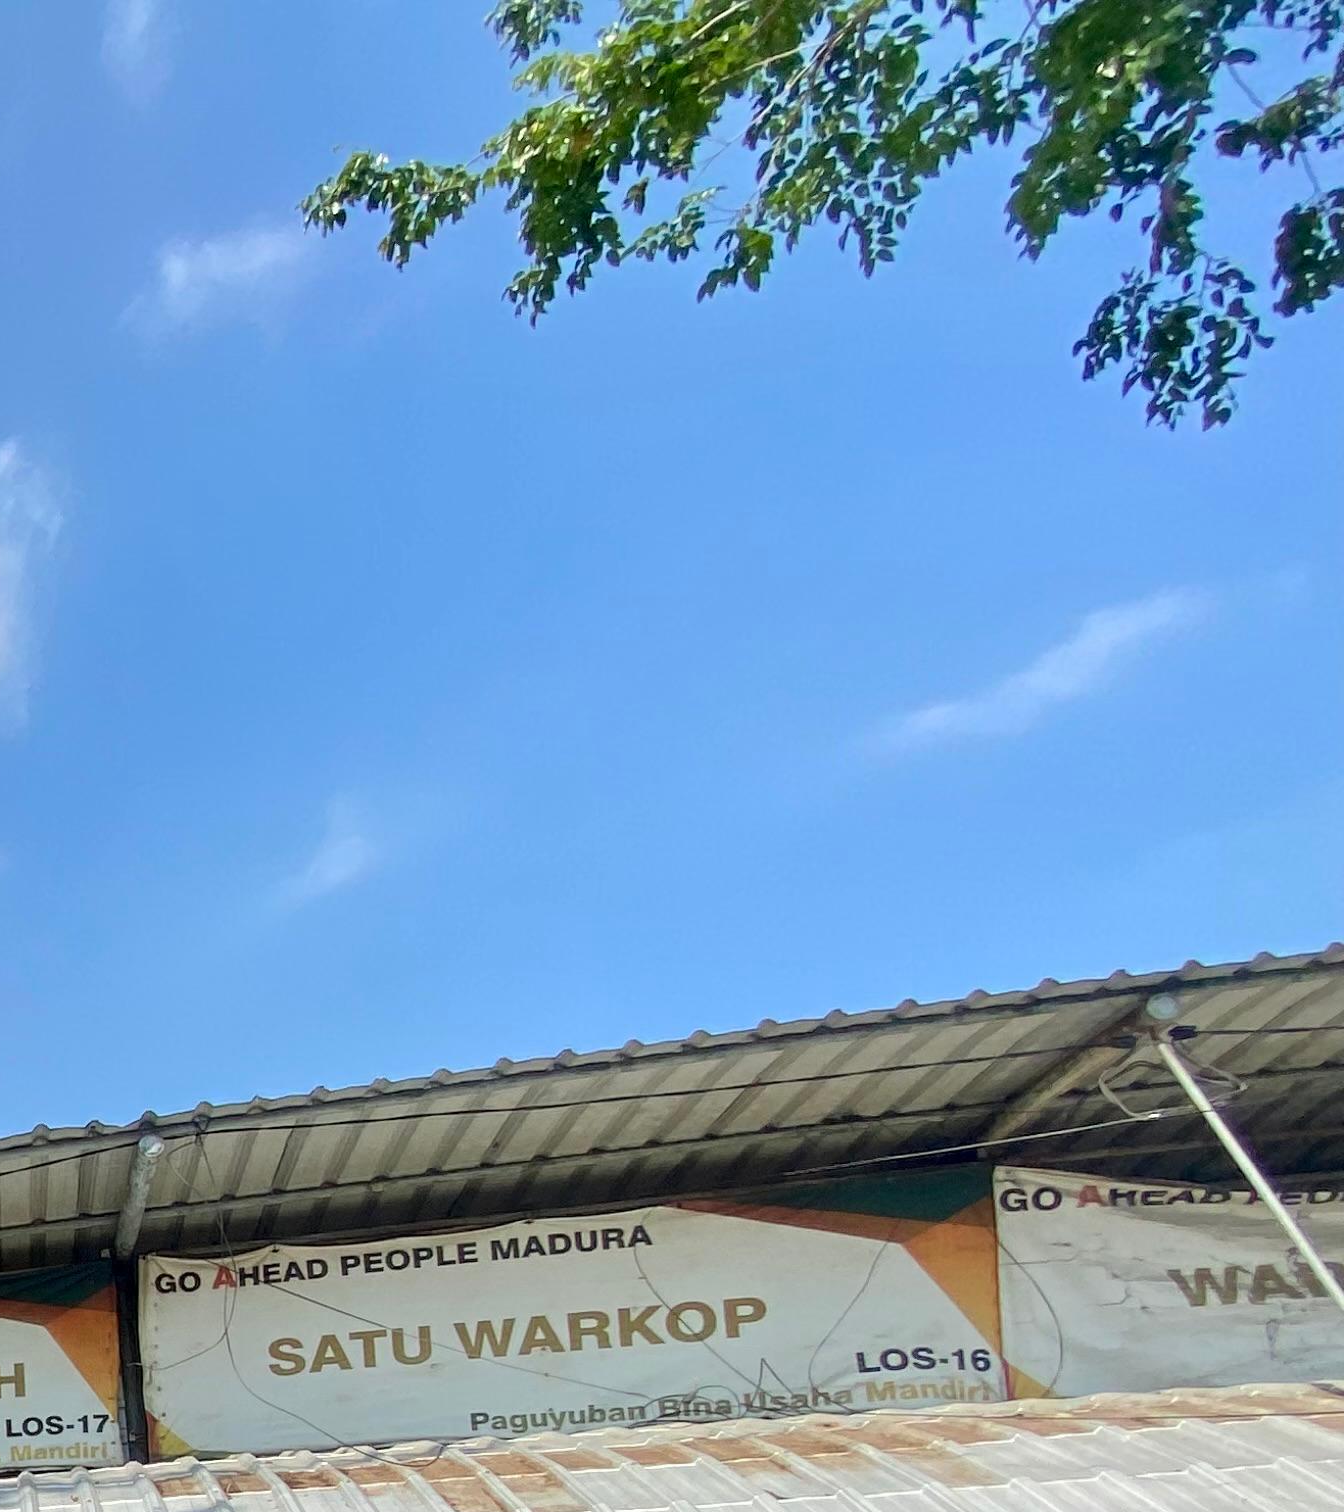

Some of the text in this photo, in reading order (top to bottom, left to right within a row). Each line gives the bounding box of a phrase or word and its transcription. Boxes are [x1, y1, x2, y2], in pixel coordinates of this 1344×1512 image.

[1000, 1186, 1062, 1212] GO
[155, 1224, 653, 1294] GO AHEAD PEOPLE MADURA
[267, 1297, 768, 1377] SATU WARKOP
[856, 1348, 992, 1375] LOS-16
[5, 1414, 110, 1438] LOS-17
[470, 1404, 646, 1434] Paguyuban
[10, 1441, 110, 1463] Mandiri
